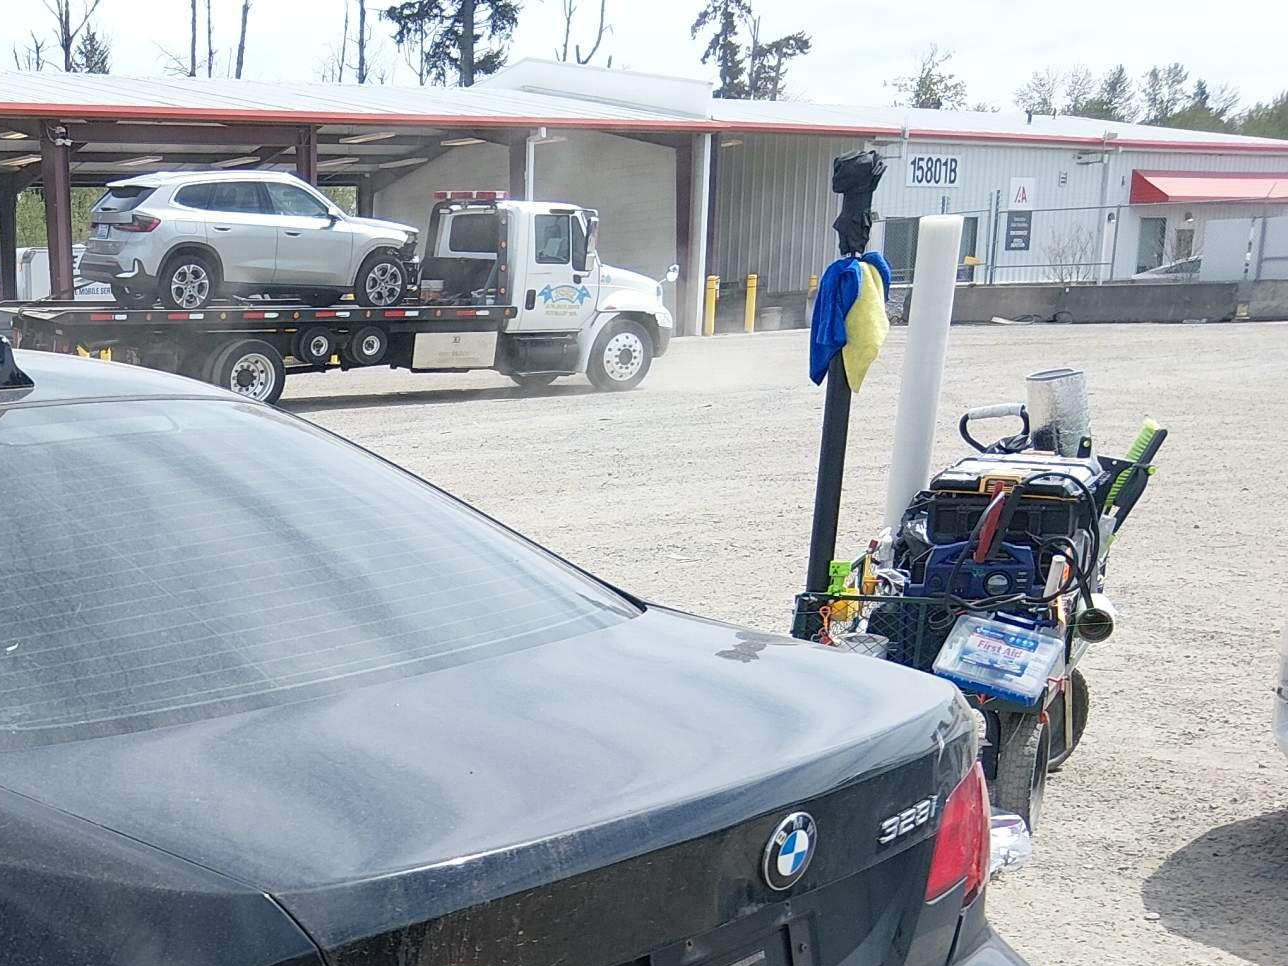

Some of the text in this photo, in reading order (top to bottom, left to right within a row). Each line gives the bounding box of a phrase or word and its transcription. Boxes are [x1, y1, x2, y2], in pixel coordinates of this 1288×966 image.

[910, 156, 958, 184] 15801B
[977, 640, 1002, 654] First
[1002, 647, 1023, 658] Aid
